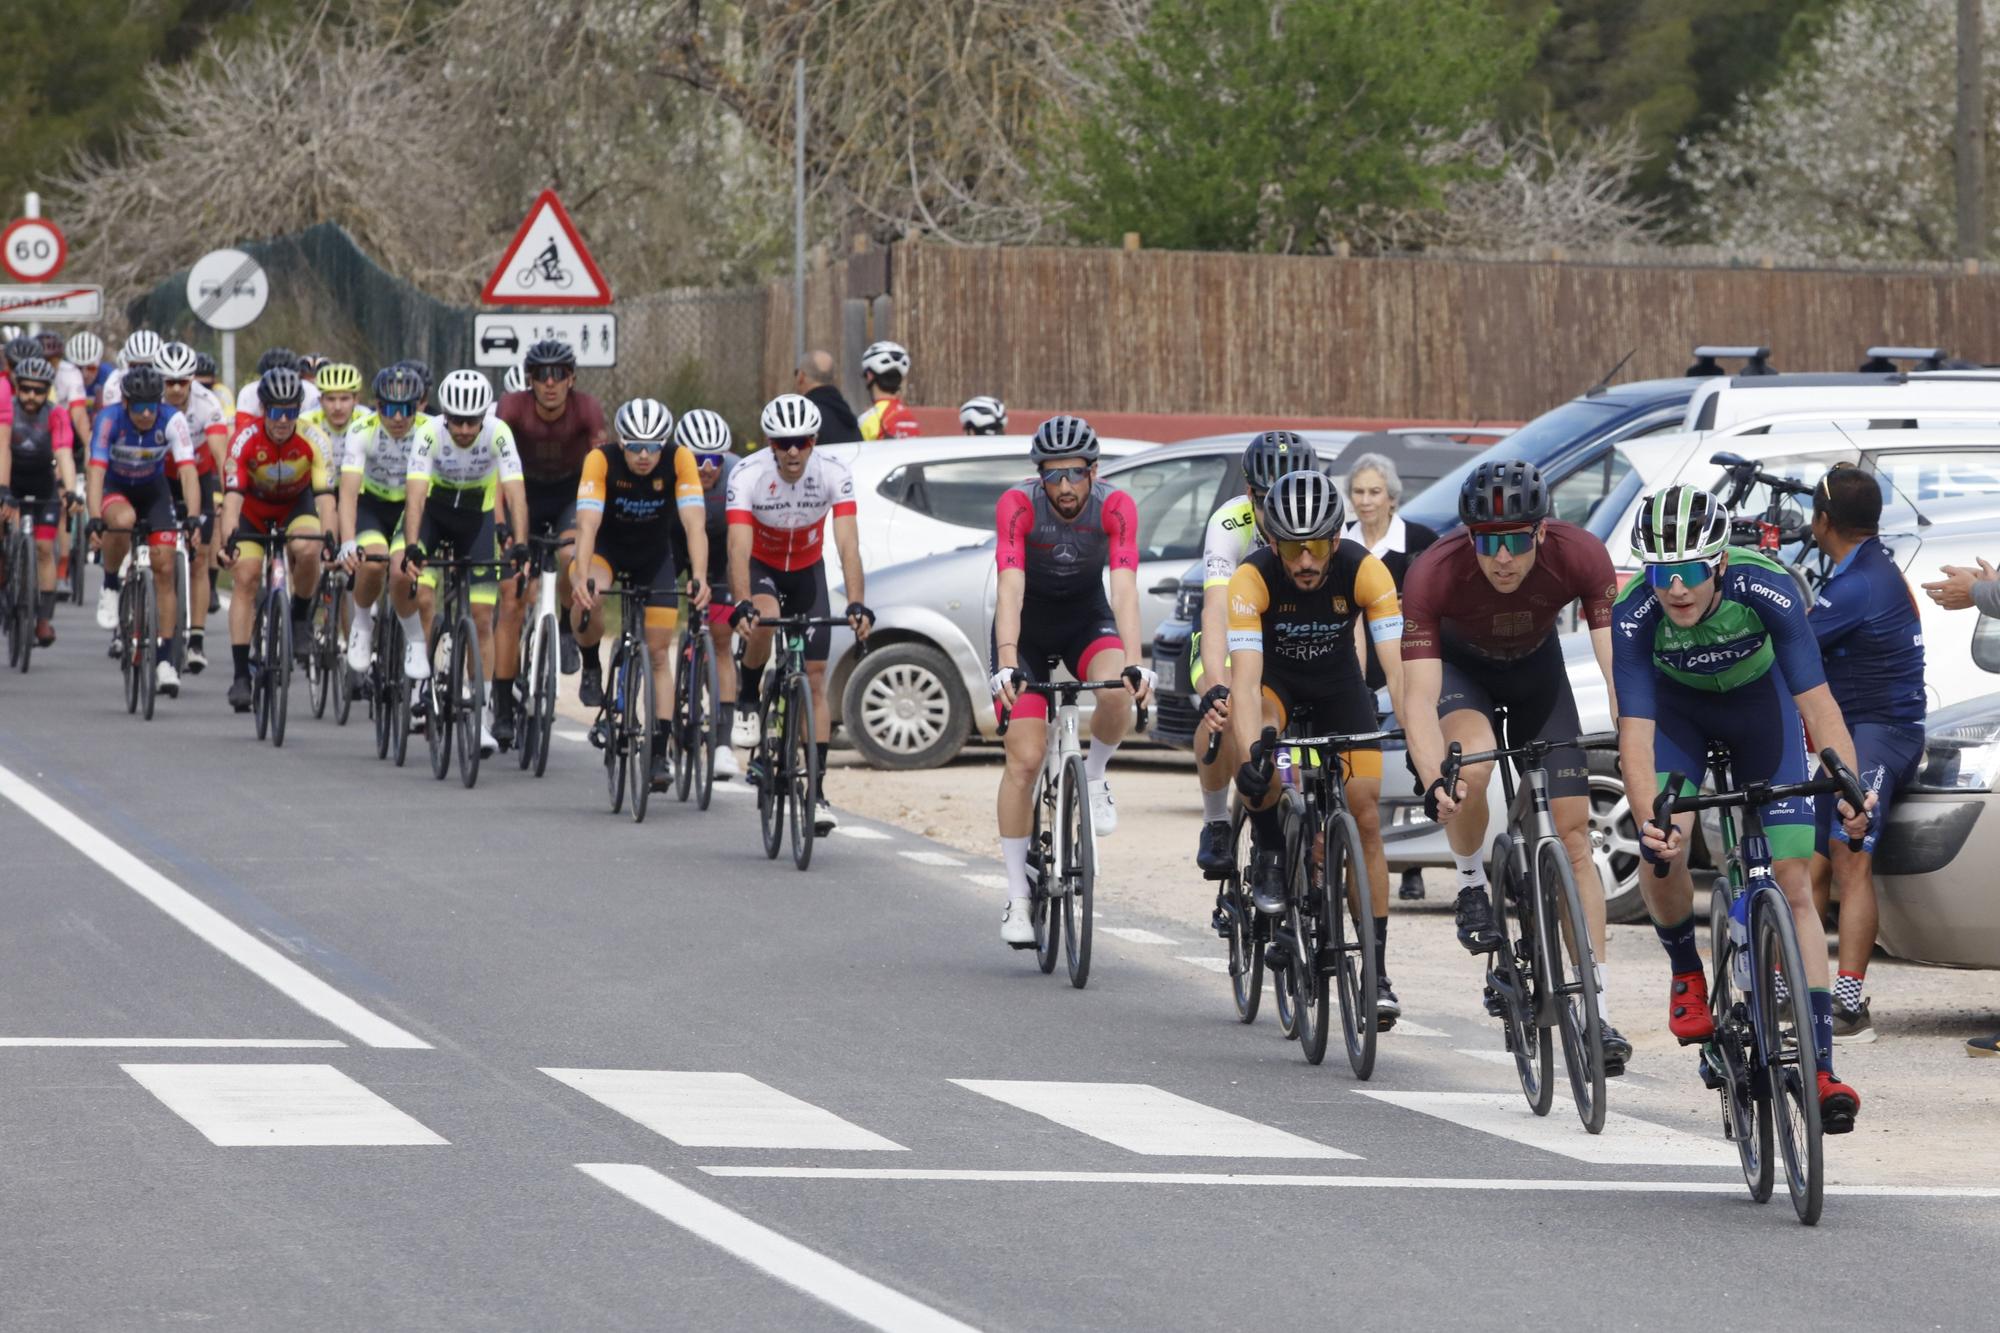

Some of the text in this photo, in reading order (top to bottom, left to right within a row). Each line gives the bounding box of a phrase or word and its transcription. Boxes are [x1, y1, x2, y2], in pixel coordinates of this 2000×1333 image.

[15, 239, 50, 261] 60
[1750, 583, 1791, 608] CORTIZO
[1769, 807, 1795, 815] amura
[1749, 866, 1771, 878] BH
